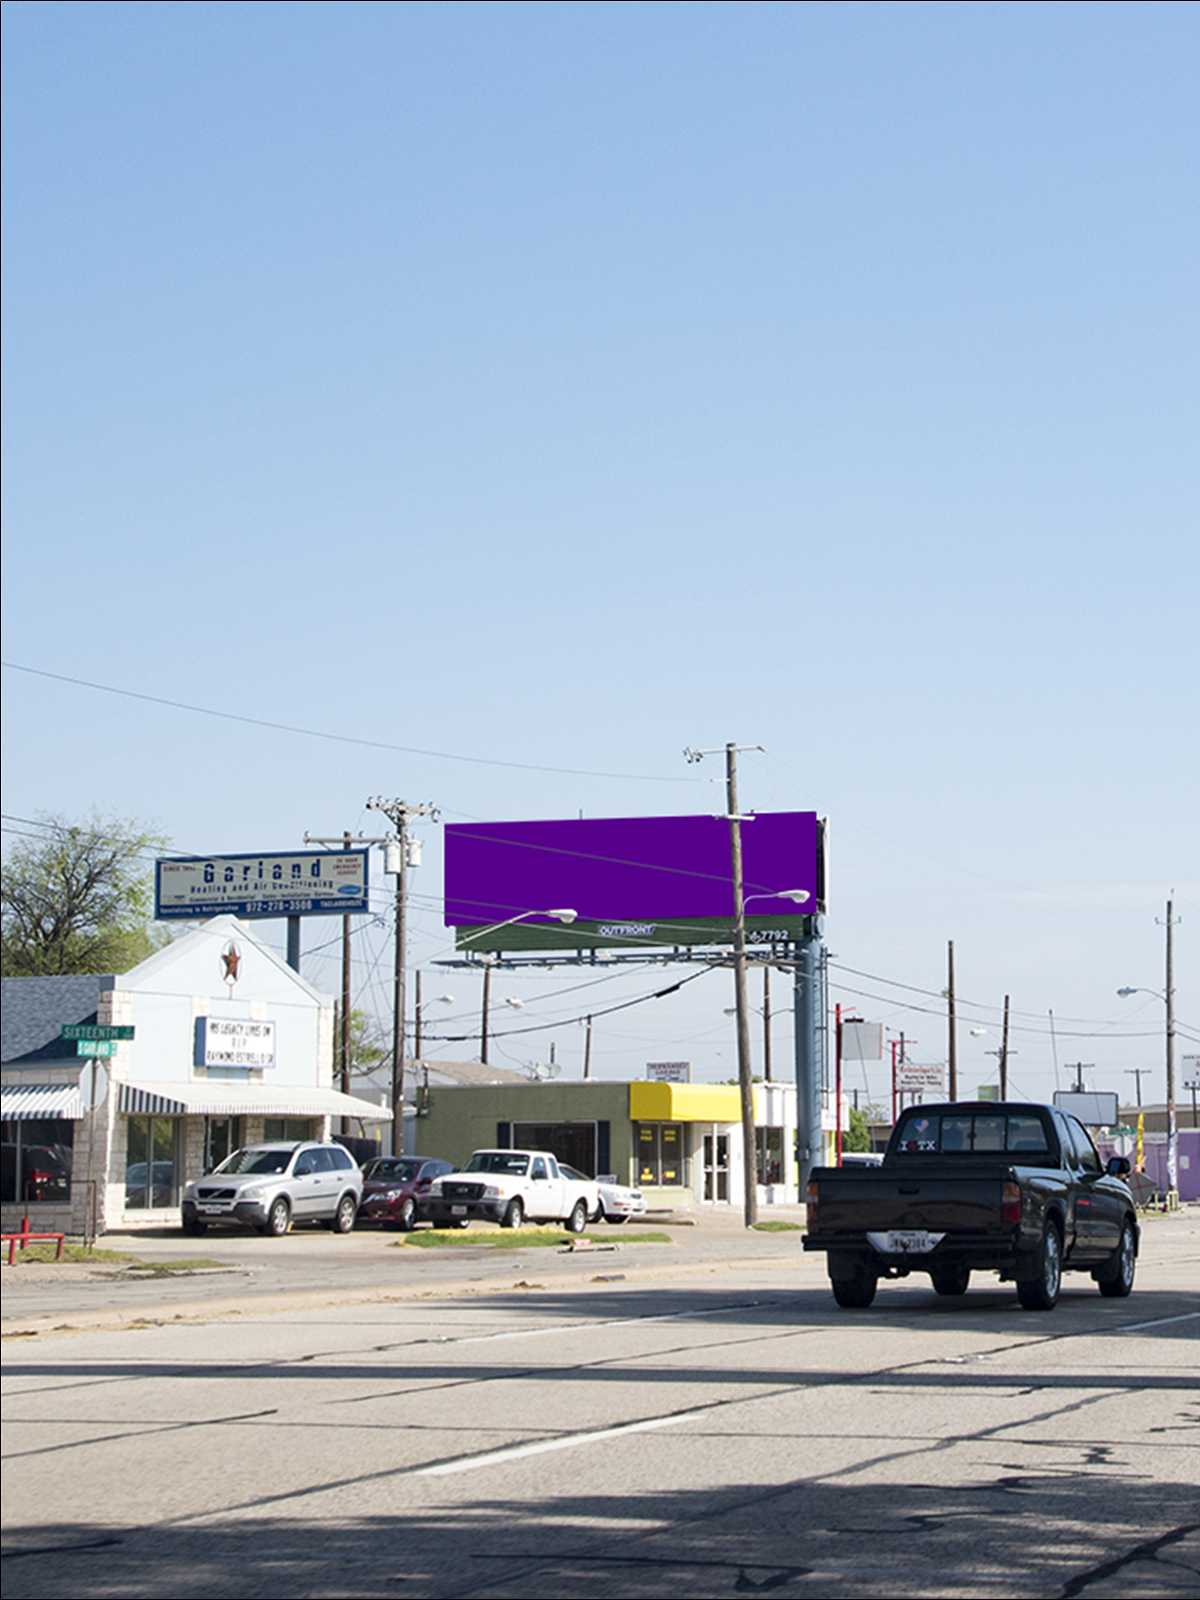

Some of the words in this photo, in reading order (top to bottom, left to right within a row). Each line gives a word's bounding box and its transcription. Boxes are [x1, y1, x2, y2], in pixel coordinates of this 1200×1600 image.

[203, 858, 321, 884] Garland
[190, 884, 227, 894] Heating
[232, 882, 249, 892] and
[254, 882, 268, 890] Air
[599, 924, 651, 936] OUTFRONT
[64, 1026, 119, 1038] SIXTEENTH
[221, 1023, 243, 1035] LEGACY
[245, 1025, 261, 1037] LIVES
[207, 1050, 234, 1062] RAYMOND
[901, 1141, 908, 1150] I
[918, 1141, 936, 1150] TX
